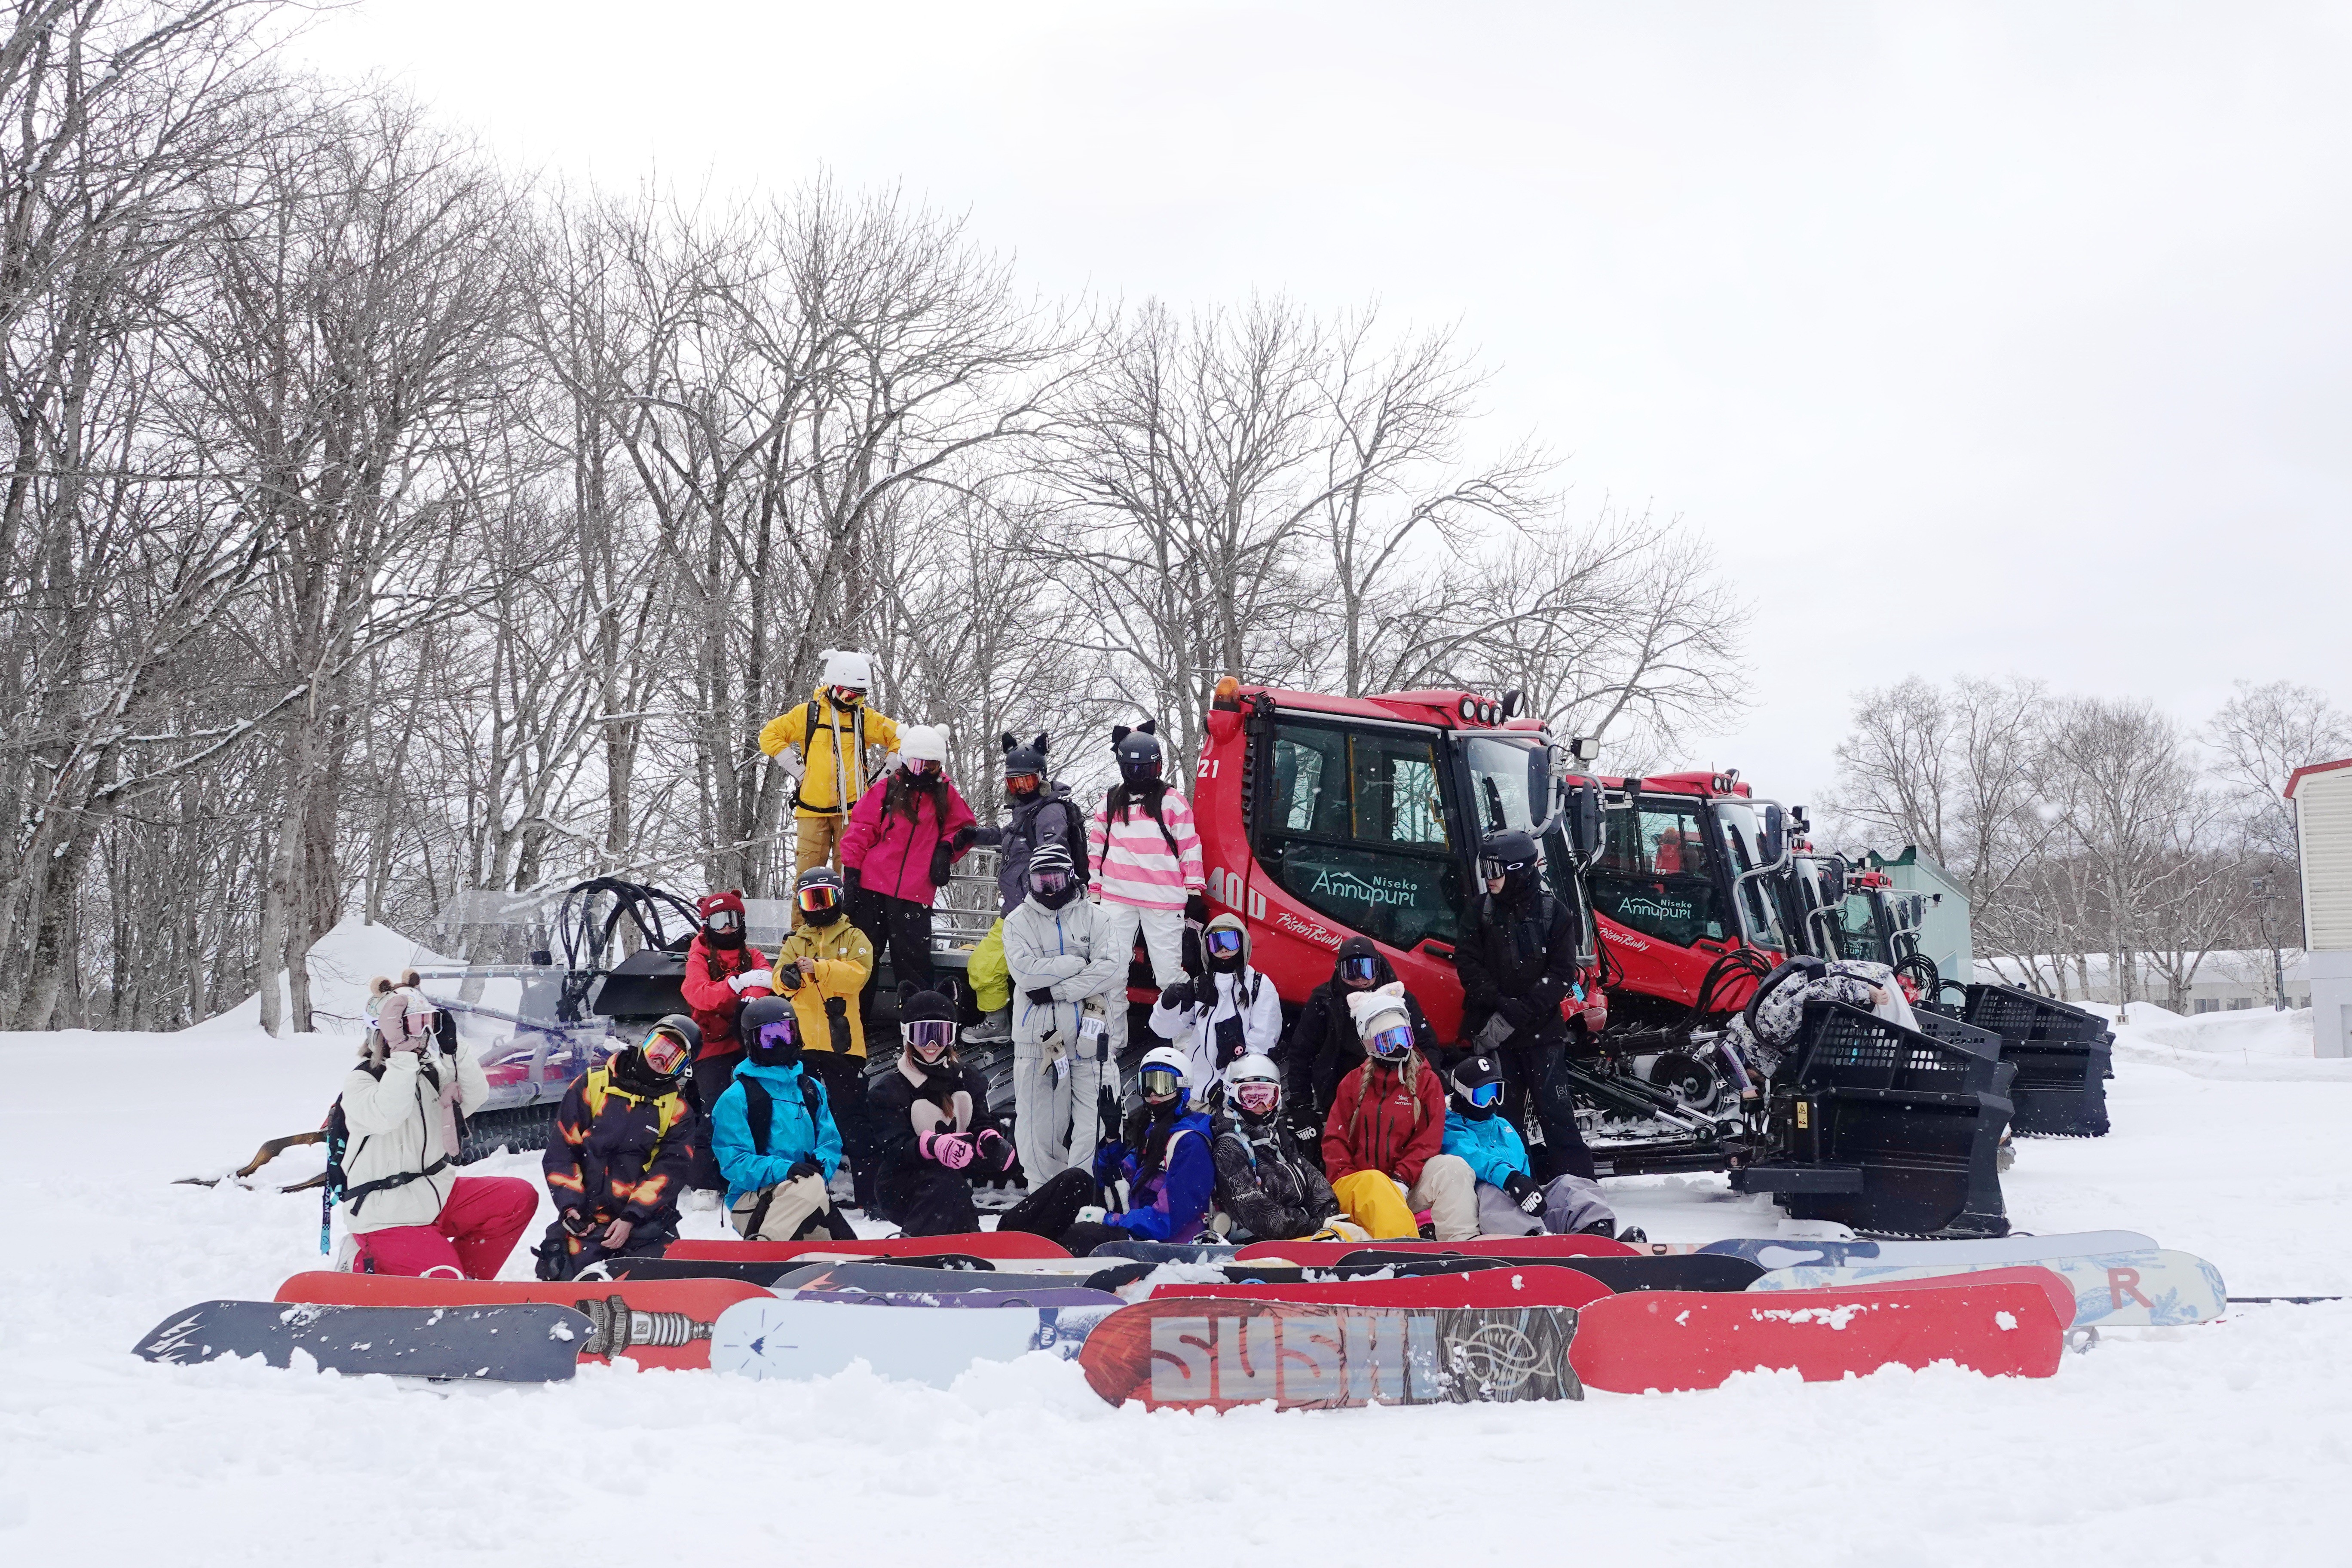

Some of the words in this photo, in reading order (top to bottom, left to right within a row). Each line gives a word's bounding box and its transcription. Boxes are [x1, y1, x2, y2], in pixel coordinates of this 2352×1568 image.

[1198, 759, 1219, 778] 21
[1206, 867, 1266, 921] 400
[1311, 870, 1415, 907] Annupuri
[1373, 876, 1418, 891] Niseko
[1618, 897, 1690, 920] Annupuri
[1661, 899, 1692, 908] Niseko
[1478, 1058, 1490, 1071] C
[1151, 1316, 1438, 1401] SUSHI
